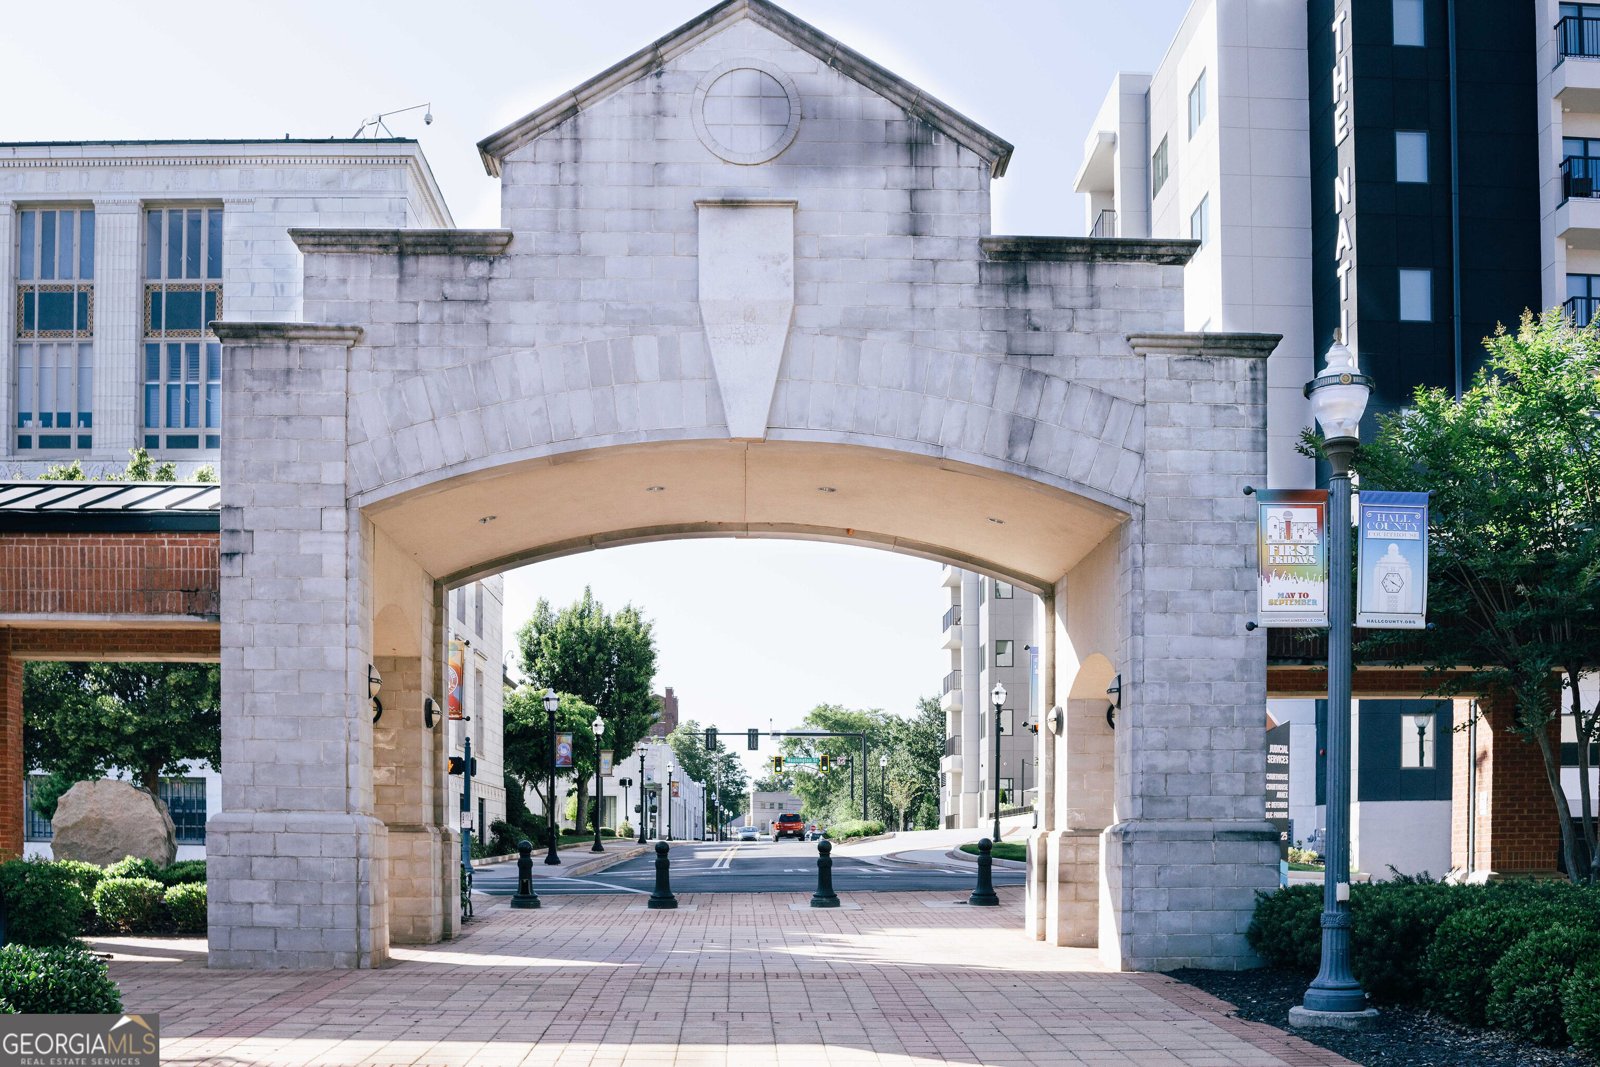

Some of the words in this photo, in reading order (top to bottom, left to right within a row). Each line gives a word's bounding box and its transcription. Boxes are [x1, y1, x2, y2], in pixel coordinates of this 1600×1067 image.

[1331, 10, 1349, 147] THE
[1377, 513, 1411, 523] HALL
[1366, 521, 1420, 531] COUNTY
[1268, 544, 1317, 556] FIRST
[1269, 555, 1317, 564] FRIDAYS
[1268, 598, 1318, 606] SEPTEMBER
[1267, 755, 1288, 764] SERVICES
[1280, 832, 1288, 840] 25
